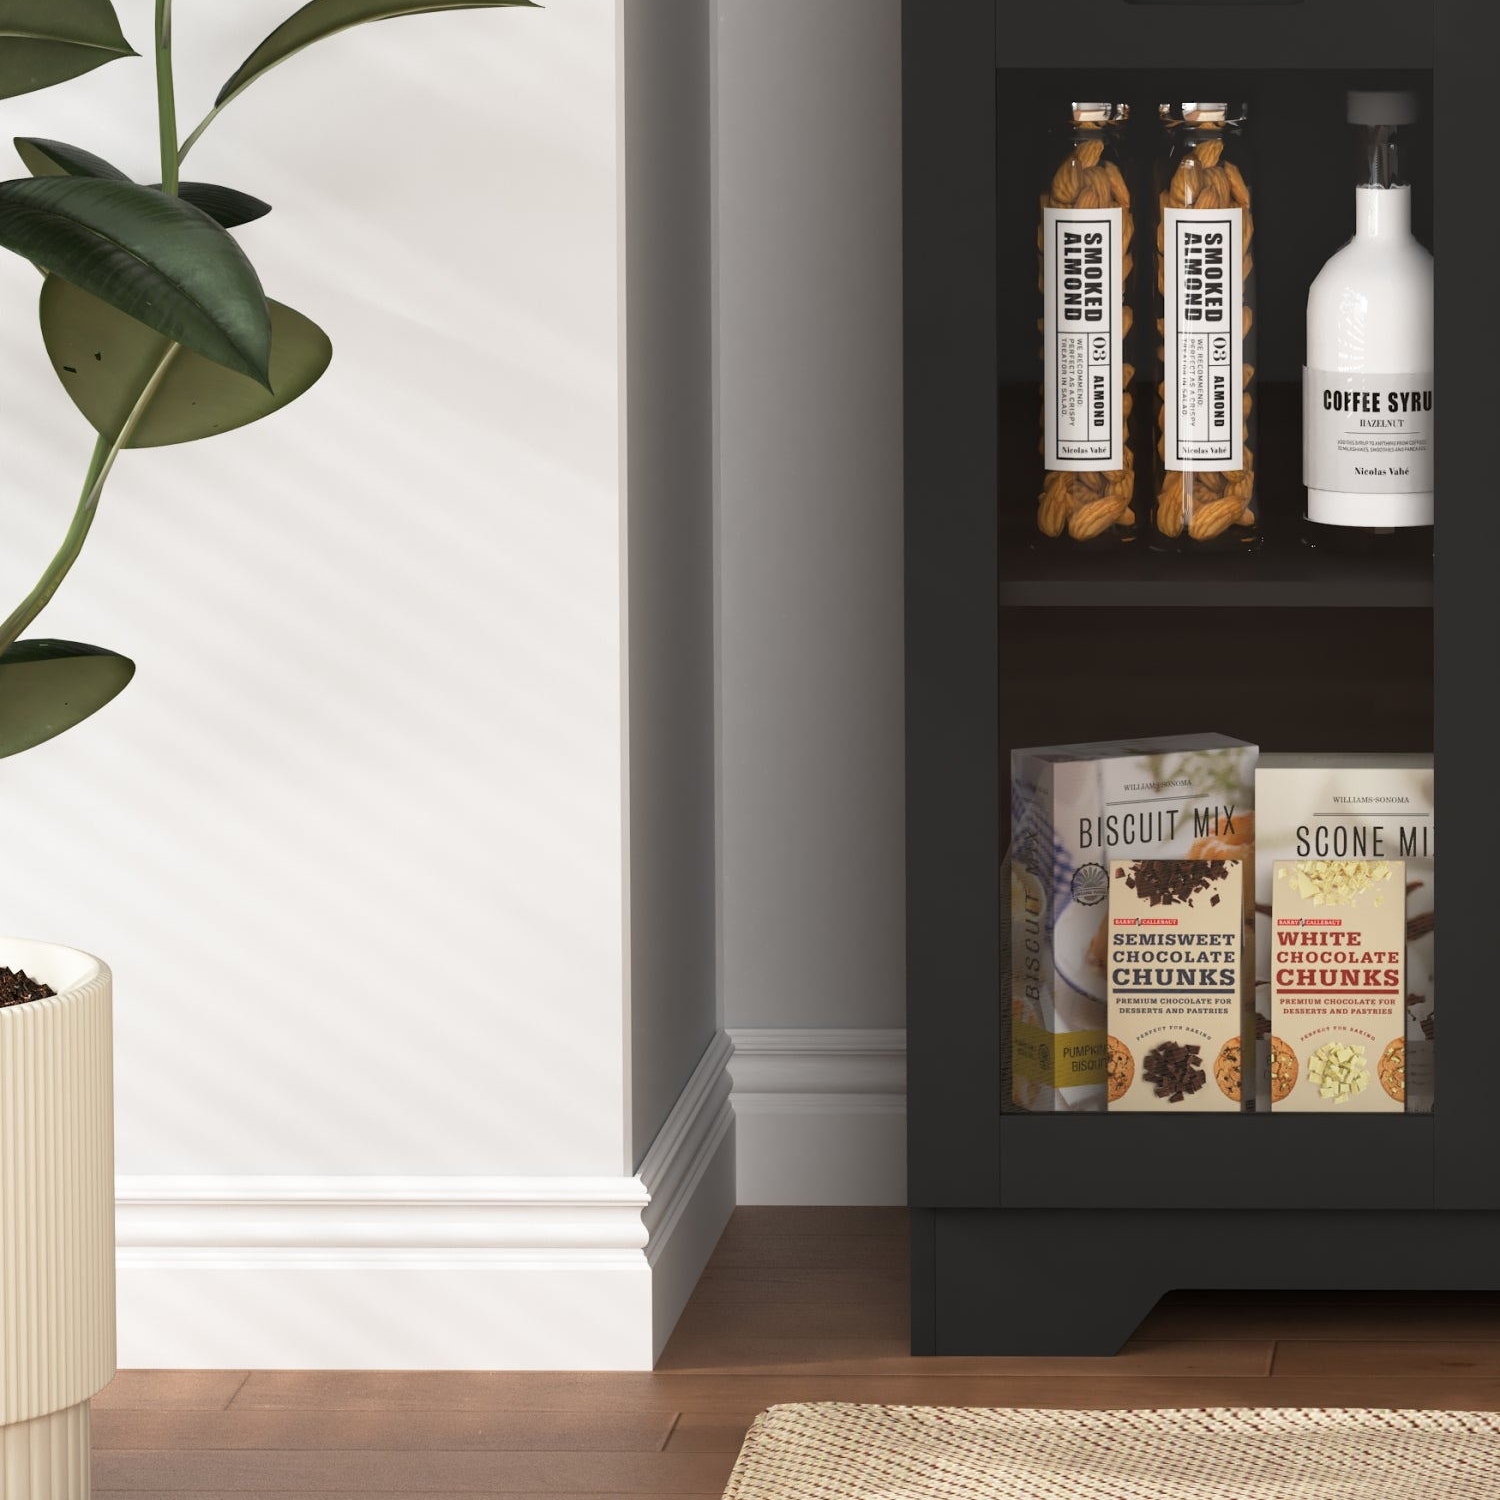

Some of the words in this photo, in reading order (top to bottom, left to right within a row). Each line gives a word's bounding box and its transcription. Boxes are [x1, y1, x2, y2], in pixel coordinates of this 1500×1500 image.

[1064, 232, 1082, 320] ALMOND
[1084, 233, 1102, 321] SMOKED
[1184, 232, 1202, 320] ALMOND
[1204, 233, 1222, 321] SMOKED
[1077, 338, 1083, 350] WE
[1093, 337, 1106, 361] 03
[1197, 338, 1203, 350] WE
[1213, 337, 1227, 361] 03
[1061, 378, 1067, 386] IN
[1069, 377, 1075, 387] AS
[1182, 378, 1188, 386] IN
[1190, 377, 1195, 387] AS
[1094, 376, 1104, 426] ALMOND
[1214, 376, 1224, 426] ALMOND
[1323, 390, 1380, 412] COFFEE
[1388, 390, 1432, 412] SYRU
[1360, 419, 1404, 427] HAZELNUT
[1355, 467, 1386, 476] Nicolas
[1389, 467, 1410, 476] Vahé
[1079, 810, 1179, 849] BISCUIT
[1194, 805, 1236, 838] MIX
[1296, 826, 1384, 857] SCONE
[1400, 826, 1434, 857] MI
[1113, 933, 1235, 946] SEMISWEET
[1277, 932, 1361, 946] WHITE
[1112, 951, 1235, 963] CHOCOLATE
[1276, 951, 1399, 964] CHOCOLATE
[1112, 968, 1235, 986] CHUNKS
[1276, 969, 1399, 987] CHUNKS
[1136, 1026, 1166, 1041] PERFECT
[1300, 1027, 1330, 1041] PERFECT
